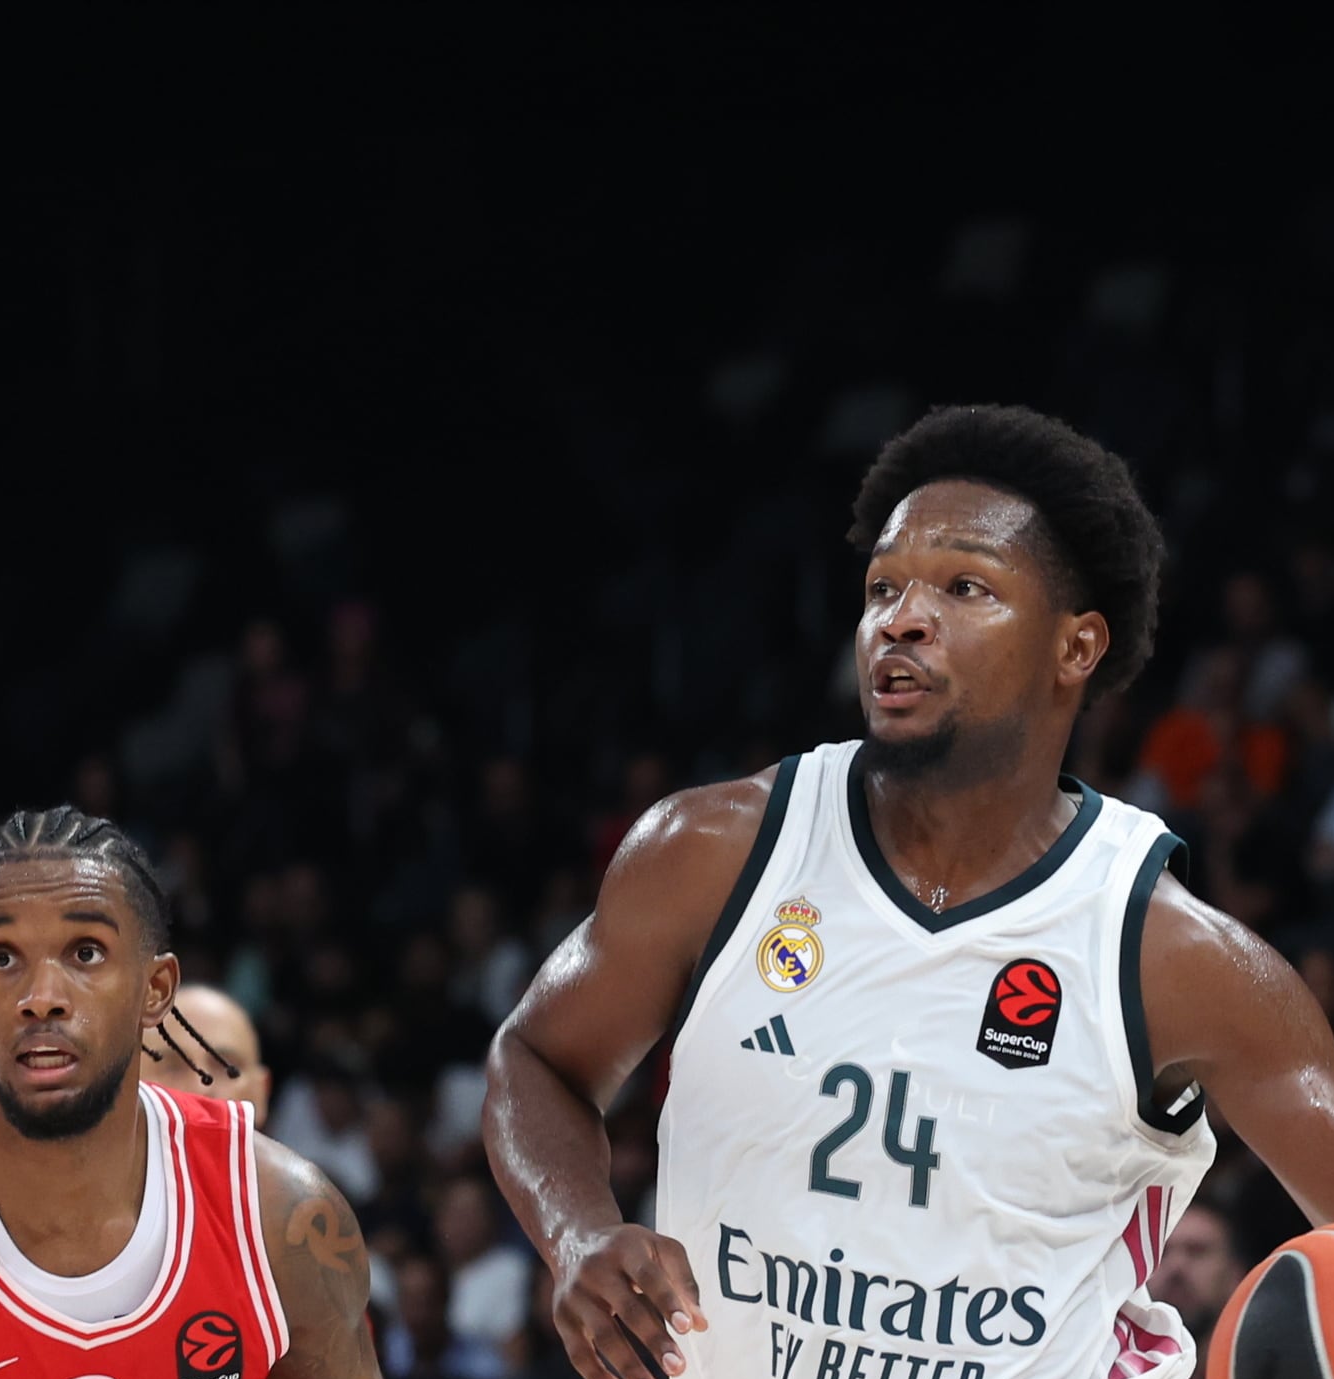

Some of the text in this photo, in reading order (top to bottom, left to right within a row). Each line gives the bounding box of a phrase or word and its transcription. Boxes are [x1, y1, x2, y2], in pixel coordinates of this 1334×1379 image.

[984, 1028, 1048, 1053] SuperCup
[808, 1062, 940, 1209] 24
[717, 1222, 1047, 1348] Emirates
